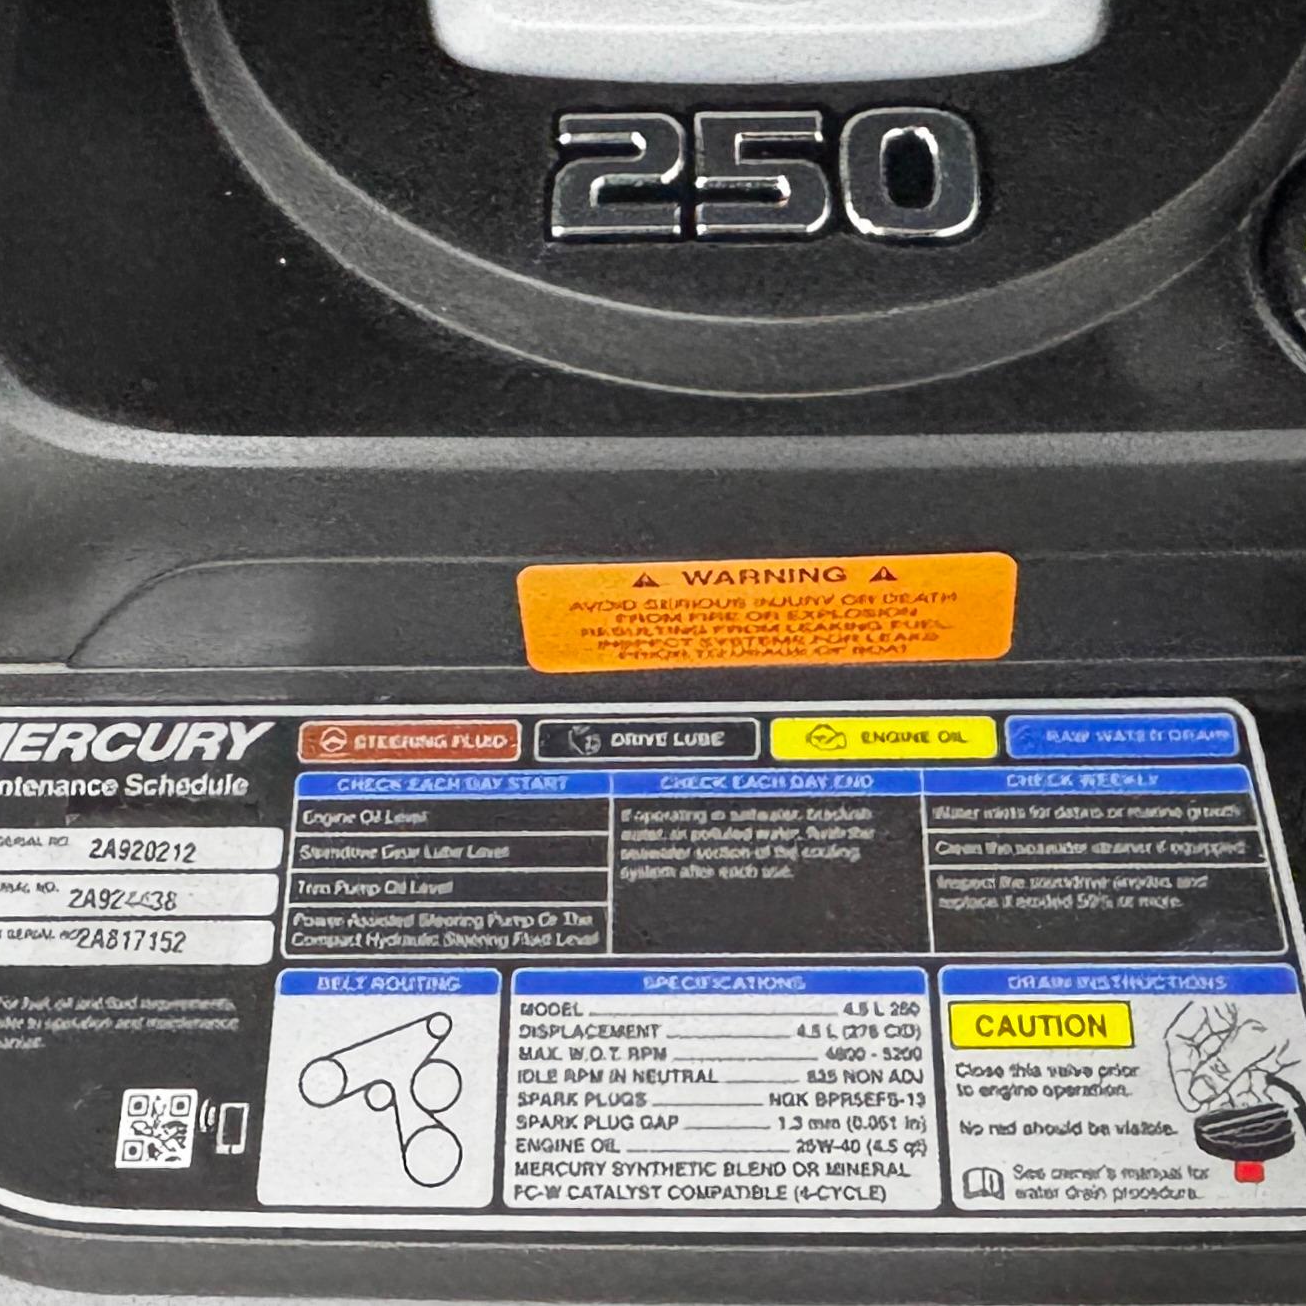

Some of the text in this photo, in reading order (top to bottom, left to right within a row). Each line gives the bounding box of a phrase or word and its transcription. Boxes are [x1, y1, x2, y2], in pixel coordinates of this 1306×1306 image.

[551, 106, 981, 239] 250
[681, 566, 847, 586] WARNING
[569, 598, 638, 612] AVOID
[882, 591, 958, 605] DEATH
[615, 612, 682, 624] FROM
[787, 606, 918, 621] EXPLOSION
[354, 733, 508, 750] STEERING FLUID
[611, 730, 725, 747] DRIVE LUBE
[860, 729, 969, 744] ENGINE OIL
[1046, 729, 1090, 743] RAW
[1095, 729, 1163, 743] WATER
[124, 772, 249, 797] Schedule
[337, 775, 569, 792] CHECK EACH DAY START
[660, 775, 727, 791] CHECK
[732, 774, 786, 790] EACH
[790, 774, 828, 790] DAY
[1006, 772, 1159, 788] CHECK WEEKLY
[302, 810, 356, 827] Engine
[359, 809, 381, 824] Oil
[89, 838, 197, 863] 2A920212
[76, 927, 187, 954] 2A817152
[370, 975, 462, 992] ROUTING
[643, 975, 806, 991] SPECIFICATIONS
[1076, 975, 1228, 991] INSTRUCTIONS
[520, 1001, 584, 1017] MODEL
[873, 1001, 885, 1017] L
[518, 1023, 662, 1040] DISPLACEMENT
[826, 1023, 839, 1040] L
[975, 1014, 1108, 1038] CAUTION
[628, 1046, 668, 1062] RPM
[517, 1068, 558, 1084] IDLE
[564, 1068, 603, 1084] RPM
[609, 1068, 626, 1084] IN
[632, 1068, 718, 1084] NEUTRAL
[843, 1068, 884, 1084] NON
[888, 1068, 924, 1085] ADJ
[955, 1061, 1140, 1082] Close this valve prior
[518, 1091, 579, 1107] SPARK
[584, 1091, 647, 1107] PLUGS
[978, 1083, 1038, 1101] engine
[516, 1114, 578, 1130] SPARK
[584, 1114, 634, 1131] PLUG
[640, 1114, 679, 1131] GAP
[778, 1115, 803, 1131] 1.3
[808, 1117, 841, 1131] mm
[960, 1119, 984, 1136] No
[989, 1119, 1017, 1136] red
[1023, 1119, 1083, 1136] should
[1088, 1119, 1110, 1136] be
[515, 1137, 585, 1154] ENGINE
[591, 1137, 621, 1153] OIL
[514, 1161, 911, 1178] MERCURY SYNTHETIC BLEND OR MINERAL
[1012, 1163, 1210, 1180] See owner's manual for
[513, 1184, 561, 1201] FC-W
[567, 1184, 662, 1201] CATALYST
[667, 1184, 788, 1201] COMPATIBLE
[1015, 1186, 1060, 1200] water
[1065, 1184, 1107, 1201] drain
